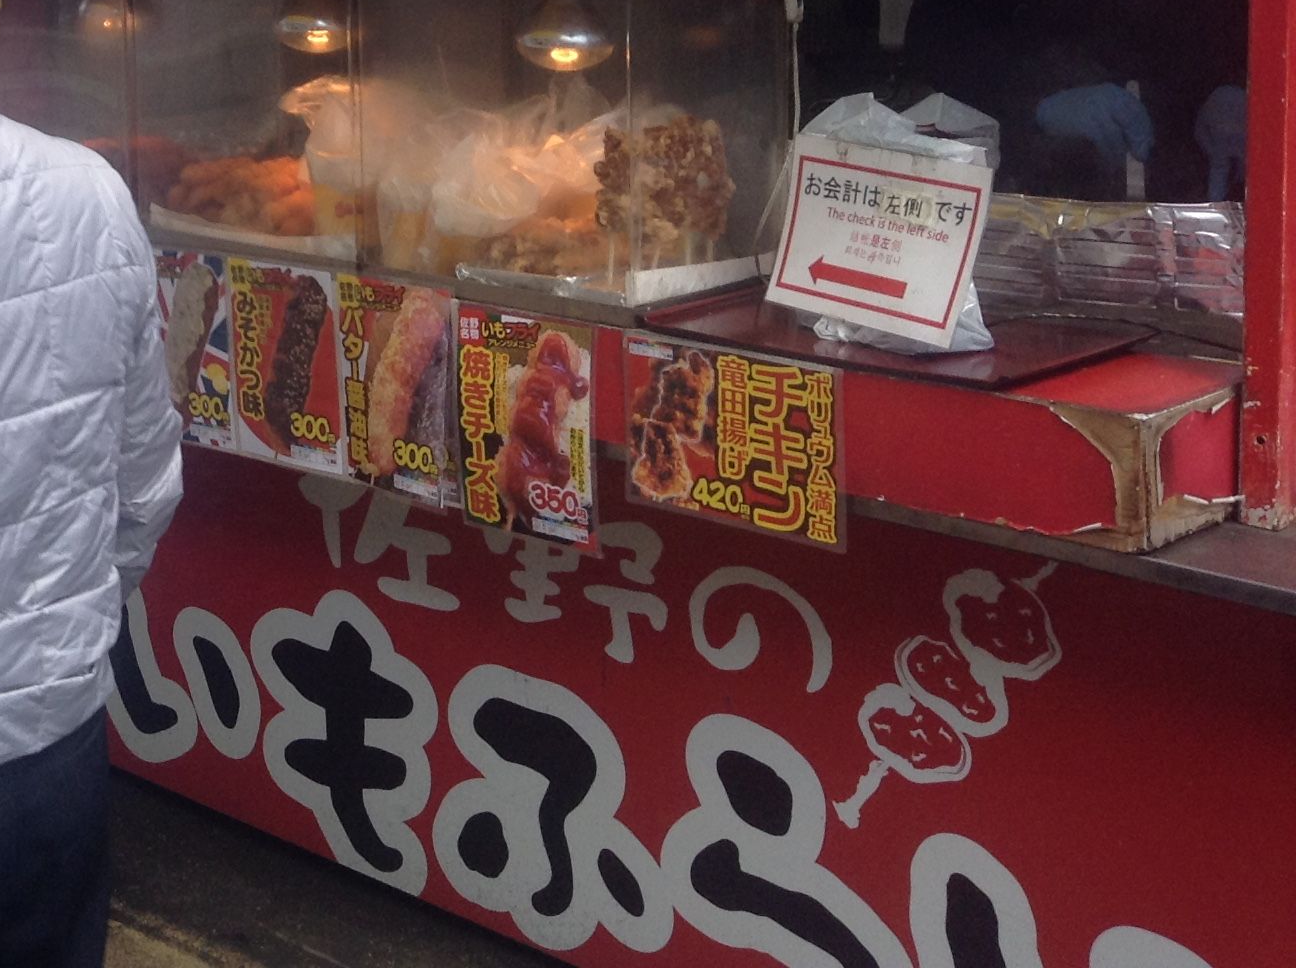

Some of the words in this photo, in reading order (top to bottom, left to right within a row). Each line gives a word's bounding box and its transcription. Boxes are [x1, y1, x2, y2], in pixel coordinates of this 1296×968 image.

[804, 173, 973, 227] お会計は左側です
[827, 206, 845, 222] The
[847, 209, 875, 228] check
[877, 216, 886, 230] is
[888, 219, 905, 233] the
[906, 223, 926, 238] left
[927, 229, 949, 244] side
[235, 290, 265, 421] みそかつ味
[481, 320, 542, 342] いもフライ
[460, 344, 502, 525] 焼きチーズ味
[717, 355, 750, 480] 竜田揚げ
[749, 363, 809, 532] チキン
[805, 372, 838, 544] ボリュウム満点
[528, 482, 590, 525] 350円
